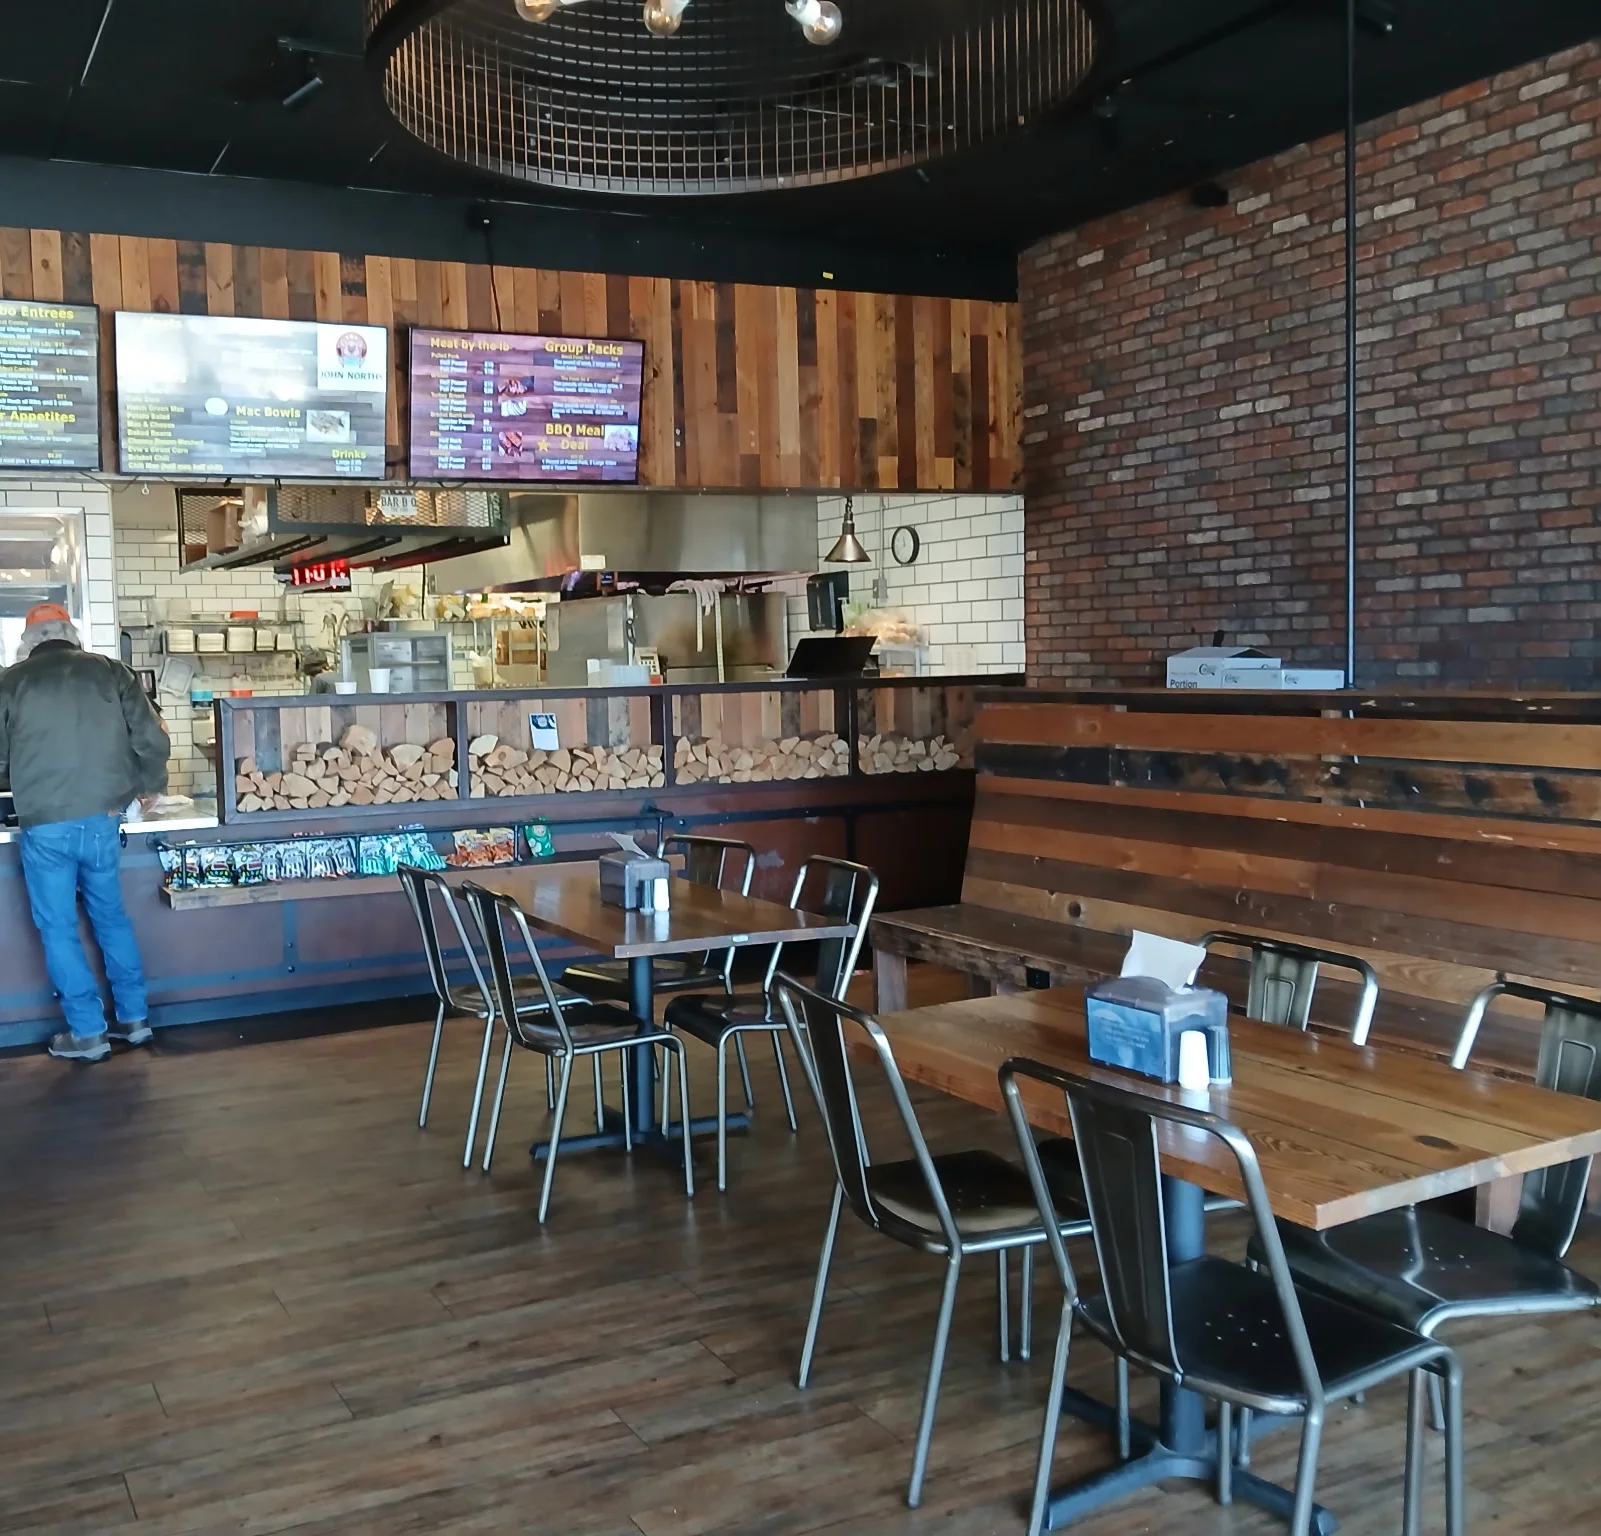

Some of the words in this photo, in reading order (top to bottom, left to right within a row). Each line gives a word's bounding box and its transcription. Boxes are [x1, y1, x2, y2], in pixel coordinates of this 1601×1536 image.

[21, 306, 74, 319] Entrees
[430, 337, 458, 349] Meat
[461, 339, 475, 352] by
[478, 340, 497, 350] the
[545, 341, 583, 356] Group
[587, 343, 624, 355] Packs
[321, 371, 344, 379] JOHN
[10, 411, 76, 423] Appetites
[235, 405, 260, 417] Mac
[264, 406, 301, 418] Bowls
[545, 423, 572, 438] BBQ
[576, 424, 604, 436] Meal
[561, 439, 589, 451] Deal
[332, 449, 367, 459] Drinks
[381, 496, 399, 507] BAR
[402, 497, 408, 507] B
[1170, 679, 1198, 688] Portion
